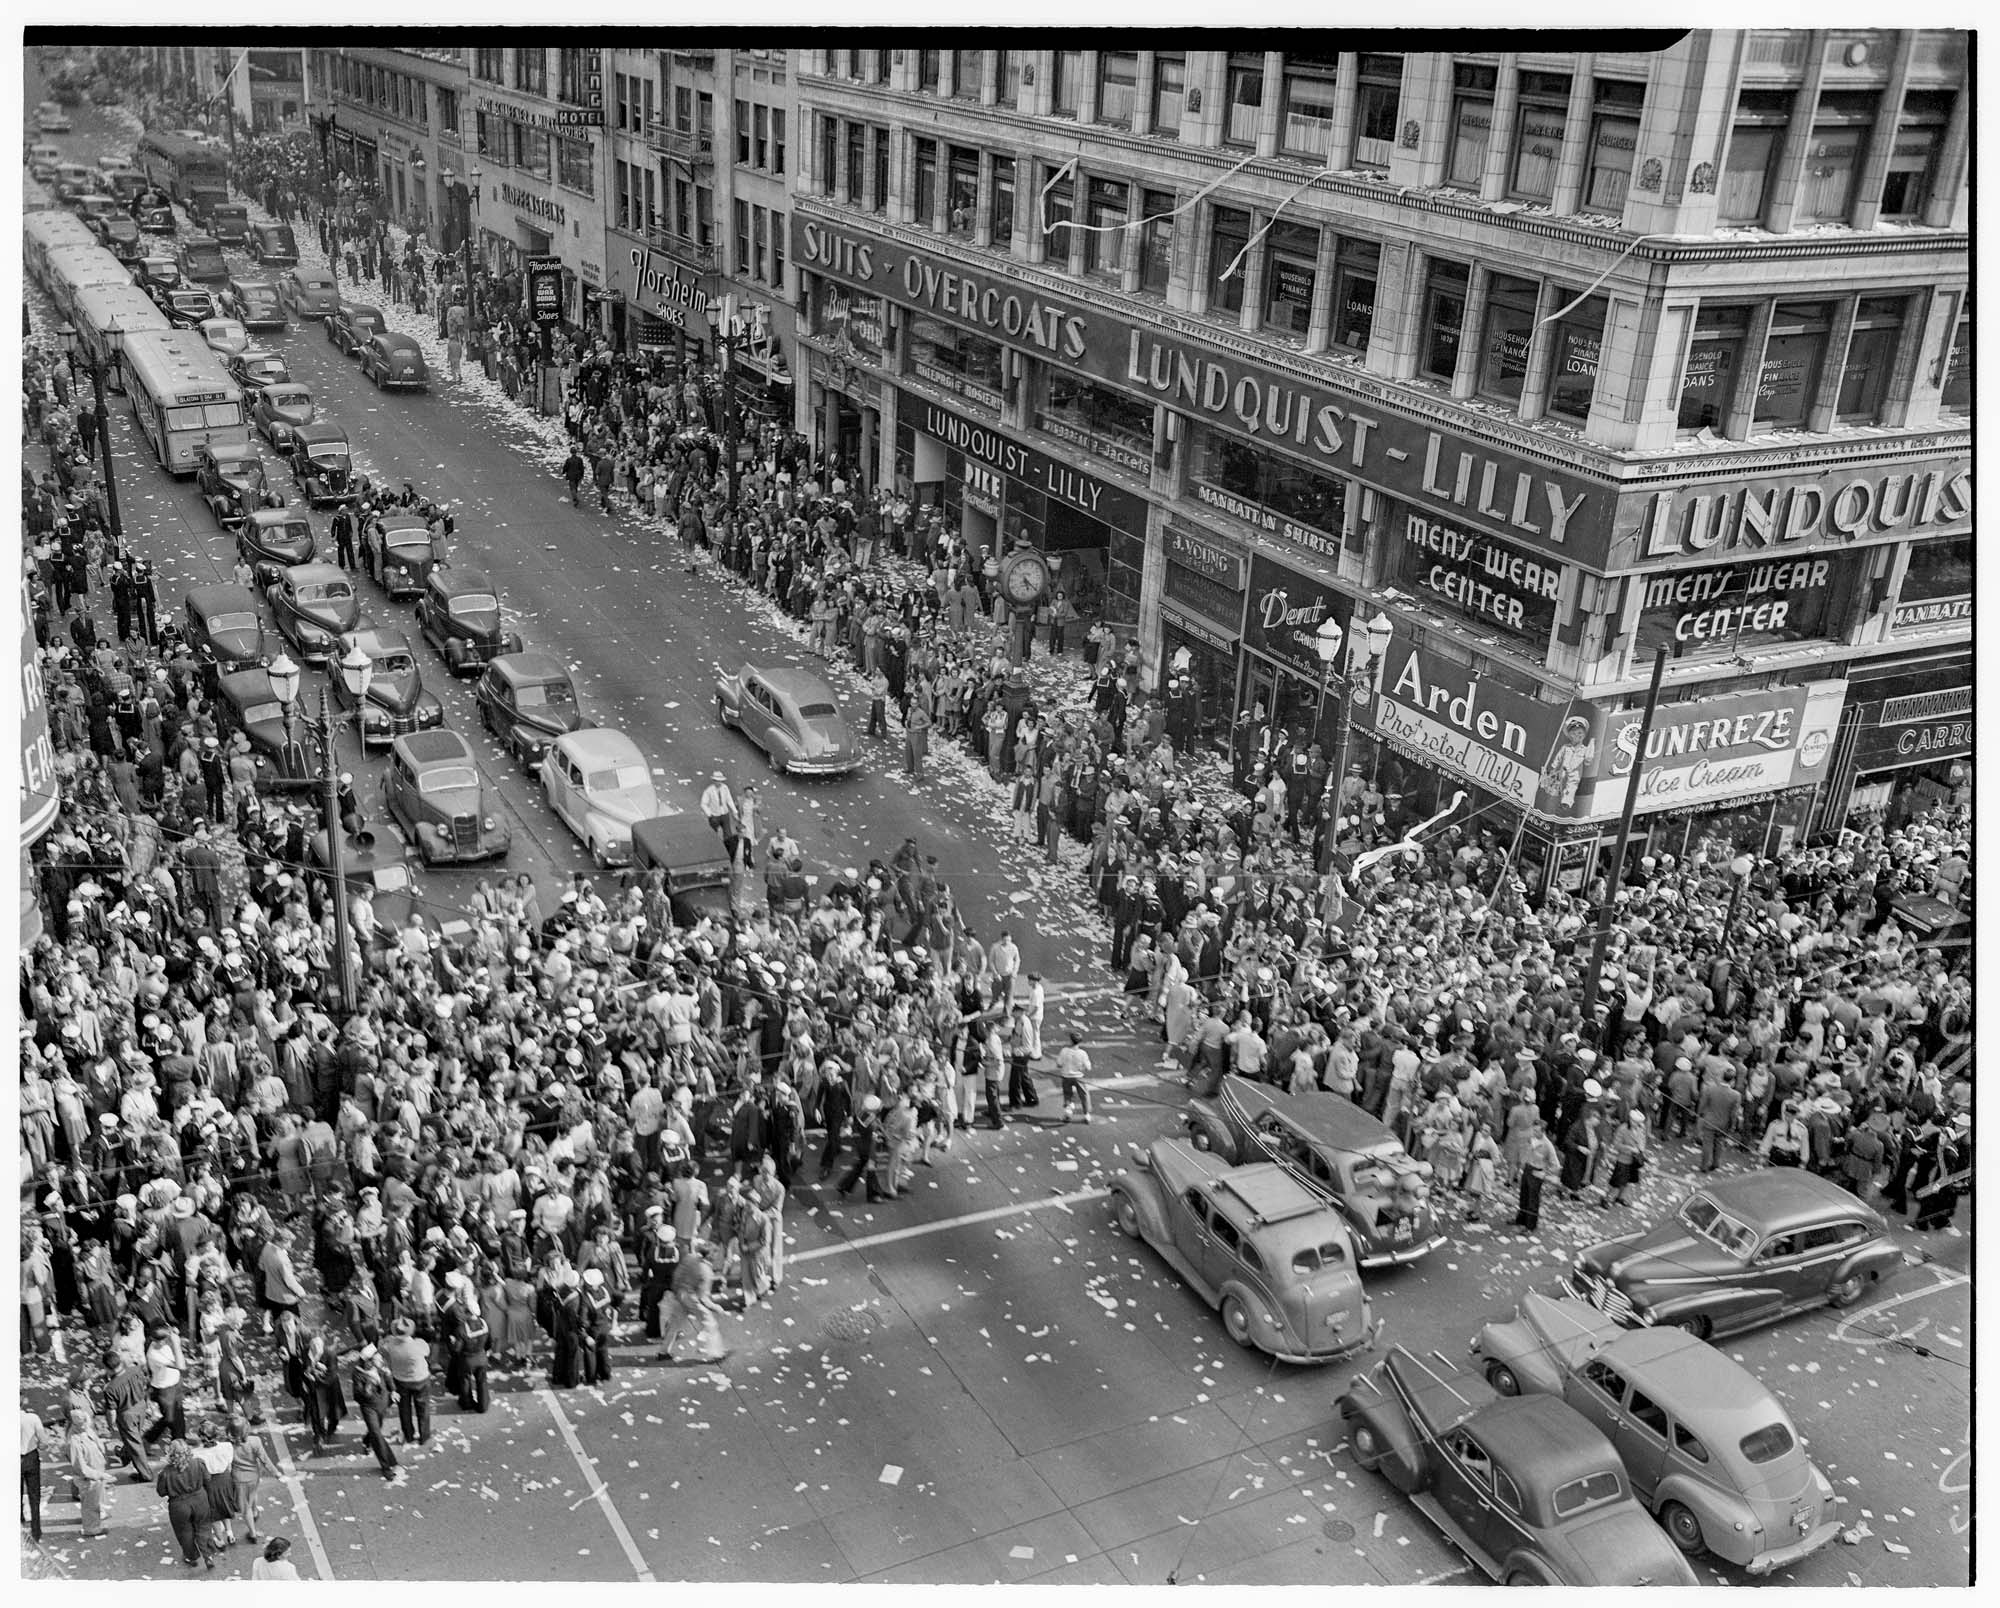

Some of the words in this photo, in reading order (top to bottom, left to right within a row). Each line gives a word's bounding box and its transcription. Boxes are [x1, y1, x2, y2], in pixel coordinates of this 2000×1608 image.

[560, 112, 602, 125] HOTEL
[529, 260, 562, 274] Florsheim
[630, 248, 707, 315] Florsheim
[1280, 272, 1312, 286] HOUSEHOLD
[804, 221, 873, 281] SUITS
[904, 255, 1087, 359] OVERCOATS
[1282, 283, 1308, 297] FINANCE
[1346, 299, 1373, 315] LOANS
[536, 310, 559, 321] Shoes
[656, 302, 685, 327] SHOES
[1495, 344, 1528, 359] FINANCE
[1128, 329, 1378, 468] LUNDQUIST
[1422, 431, 1587, 543] LILLY
[927, 407, 1029, 476] LUNDQUIST
[1048, 464, 1102, 512] LILLY
[1198, 486, 1277, 531] MANHATTAN
[1283, 523, 1335, 556] SHIRTS
[1485, 545, 1560, 601] WEAR
[1746, 559, 1829, 594] WEAR
[1430, 565, 1524, 630] CENTER
[1675, 600, 1789, 641] CENTER
[1392, 650, 1528, 758] Arden
[1379, 700, 1473, 769] Protected
[1474, 745, 1524, 798] Milk
[1608, 707, 1795, 777] SUNFREZE
[1640, 765, 1681, 796] Ice
[1688, 758, 1765, 790] Cream
[1668, 802, 1716, 816] FOUNTAIN
